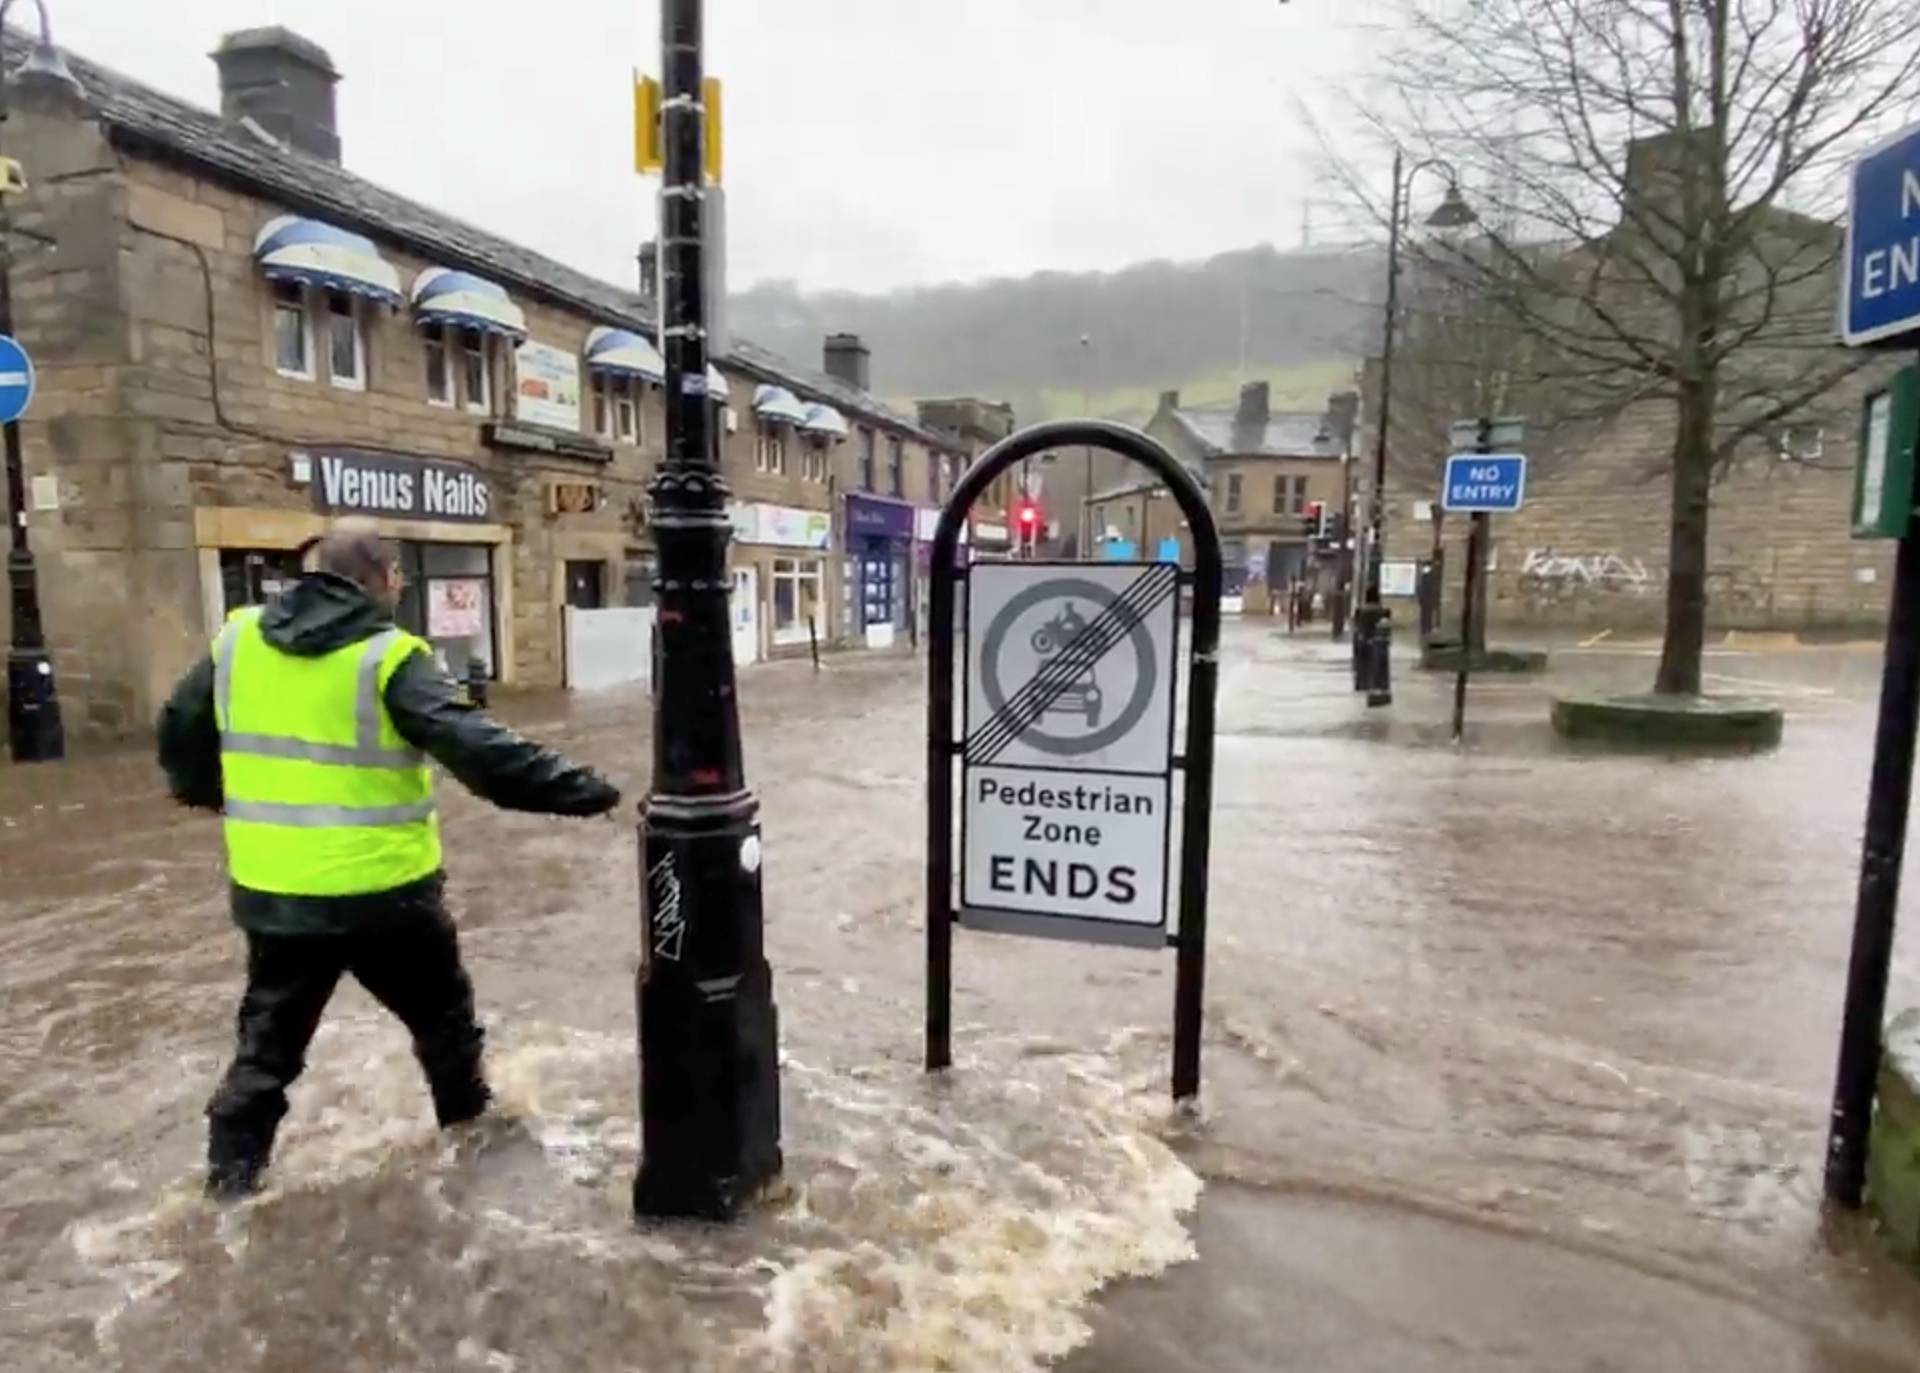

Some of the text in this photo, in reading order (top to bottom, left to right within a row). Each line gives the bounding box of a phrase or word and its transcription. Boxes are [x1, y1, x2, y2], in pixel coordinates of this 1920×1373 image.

[321, 456, 488, 516] Venus Nails
[1470, 465, 1500, 482] NO
[1452, 483, 1515, 500] ENTRY
[979, 778, 1153, 815] Pedestrian
[1023, 815, 1102, 846] Zone
[990, 855, 1136, 904] ENDS
